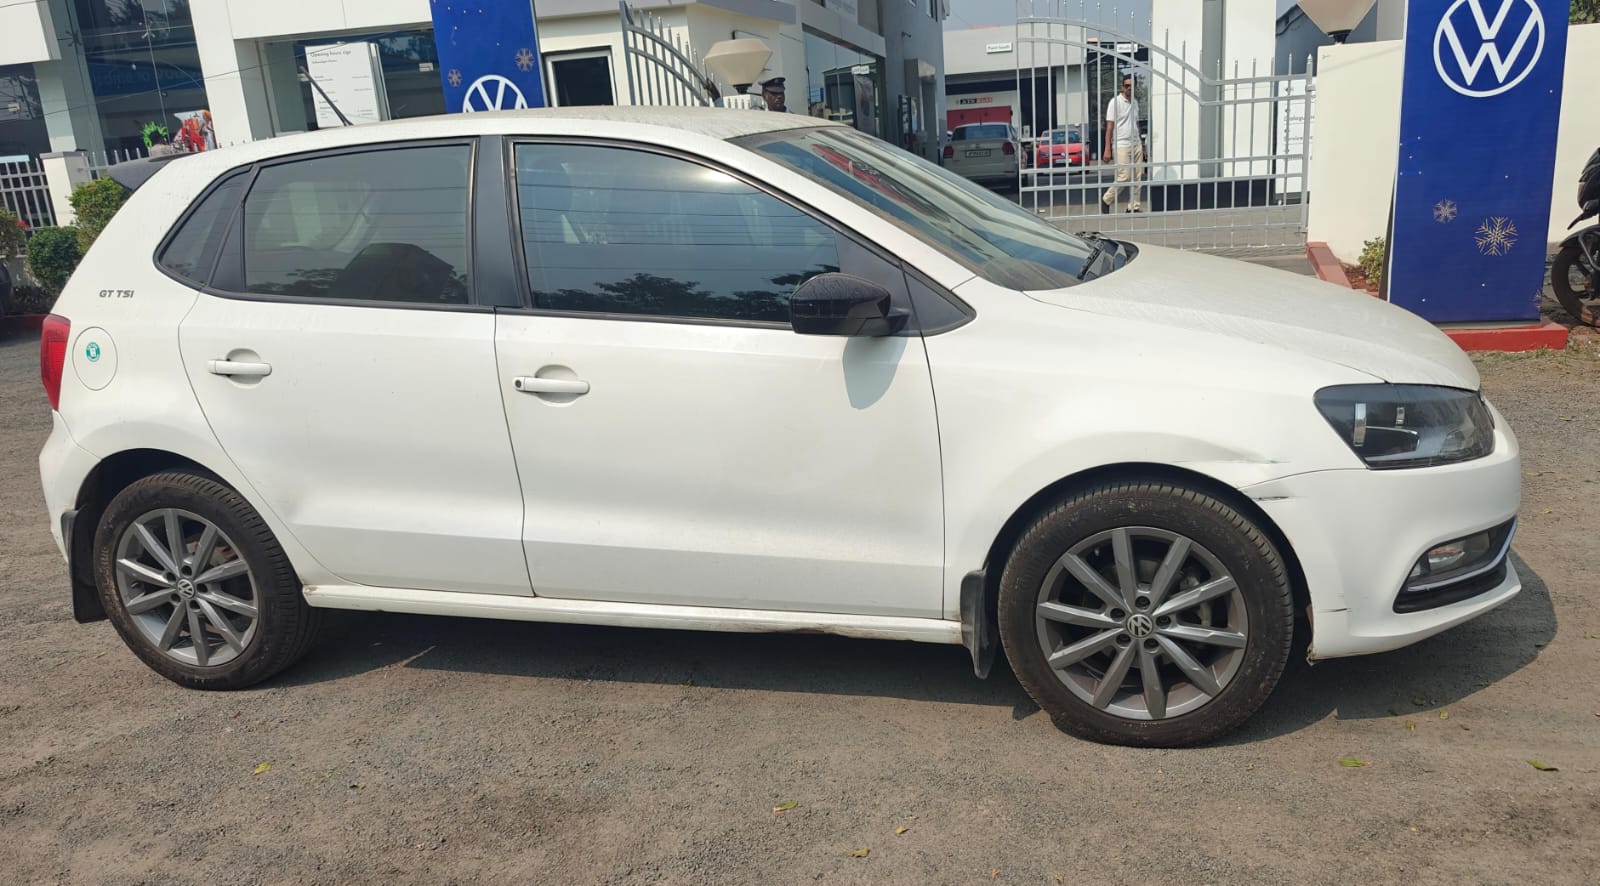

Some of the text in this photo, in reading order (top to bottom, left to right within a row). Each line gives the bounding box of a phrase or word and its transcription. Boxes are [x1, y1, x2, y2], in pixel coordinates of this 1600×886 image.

[1438, 0, 1542, 90] VW
[99, 289, 135, 298] GT TSI
